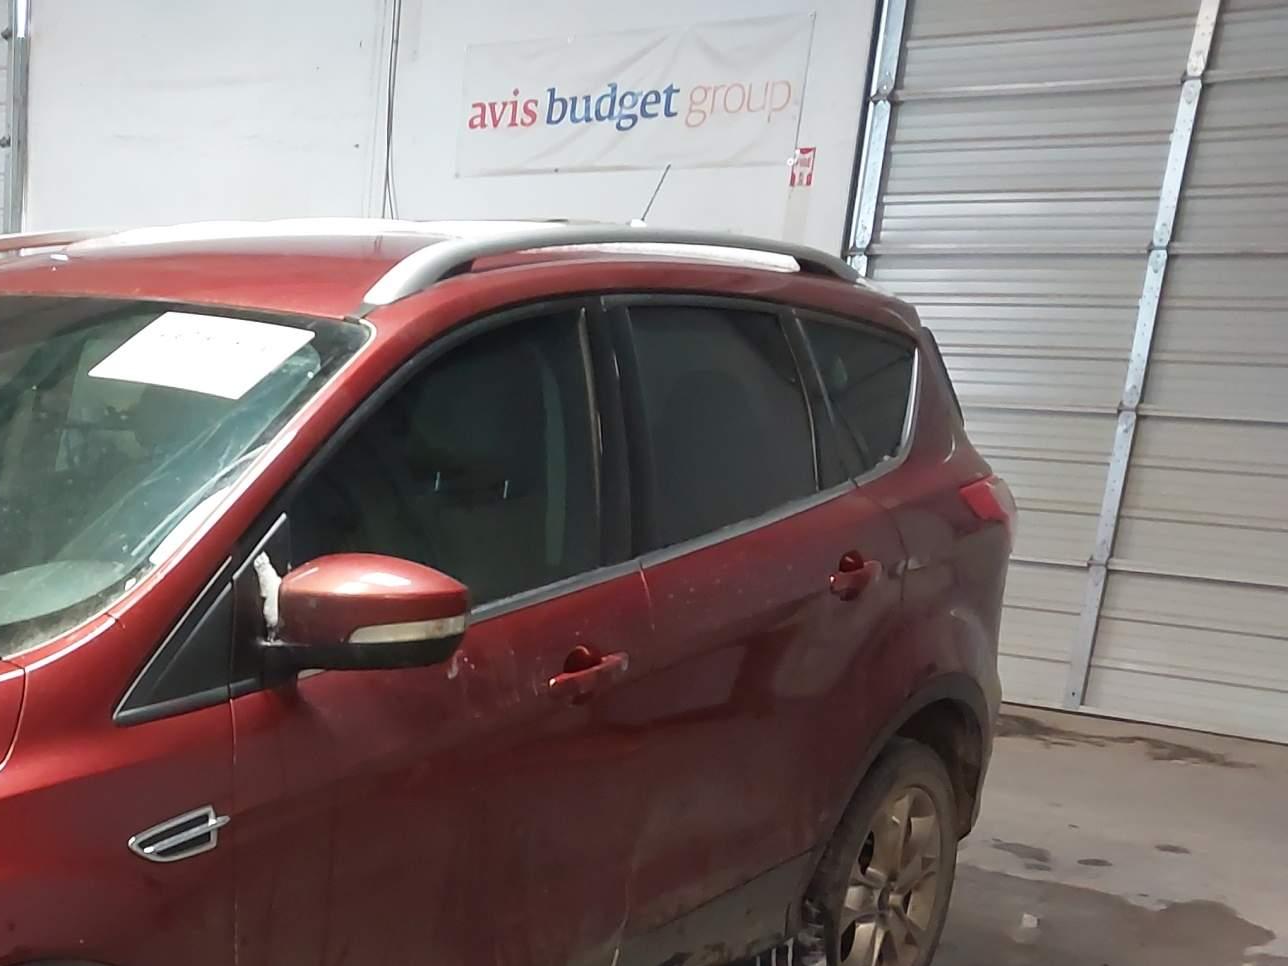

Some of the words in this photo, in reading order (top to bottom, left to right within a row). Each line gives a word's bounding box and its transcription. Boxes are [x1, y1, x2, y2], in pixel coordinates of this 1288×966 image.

[468, 88, 539, 129] avis
[546, 82, 680, 131] budget
[685, 79, 792, 128] group
